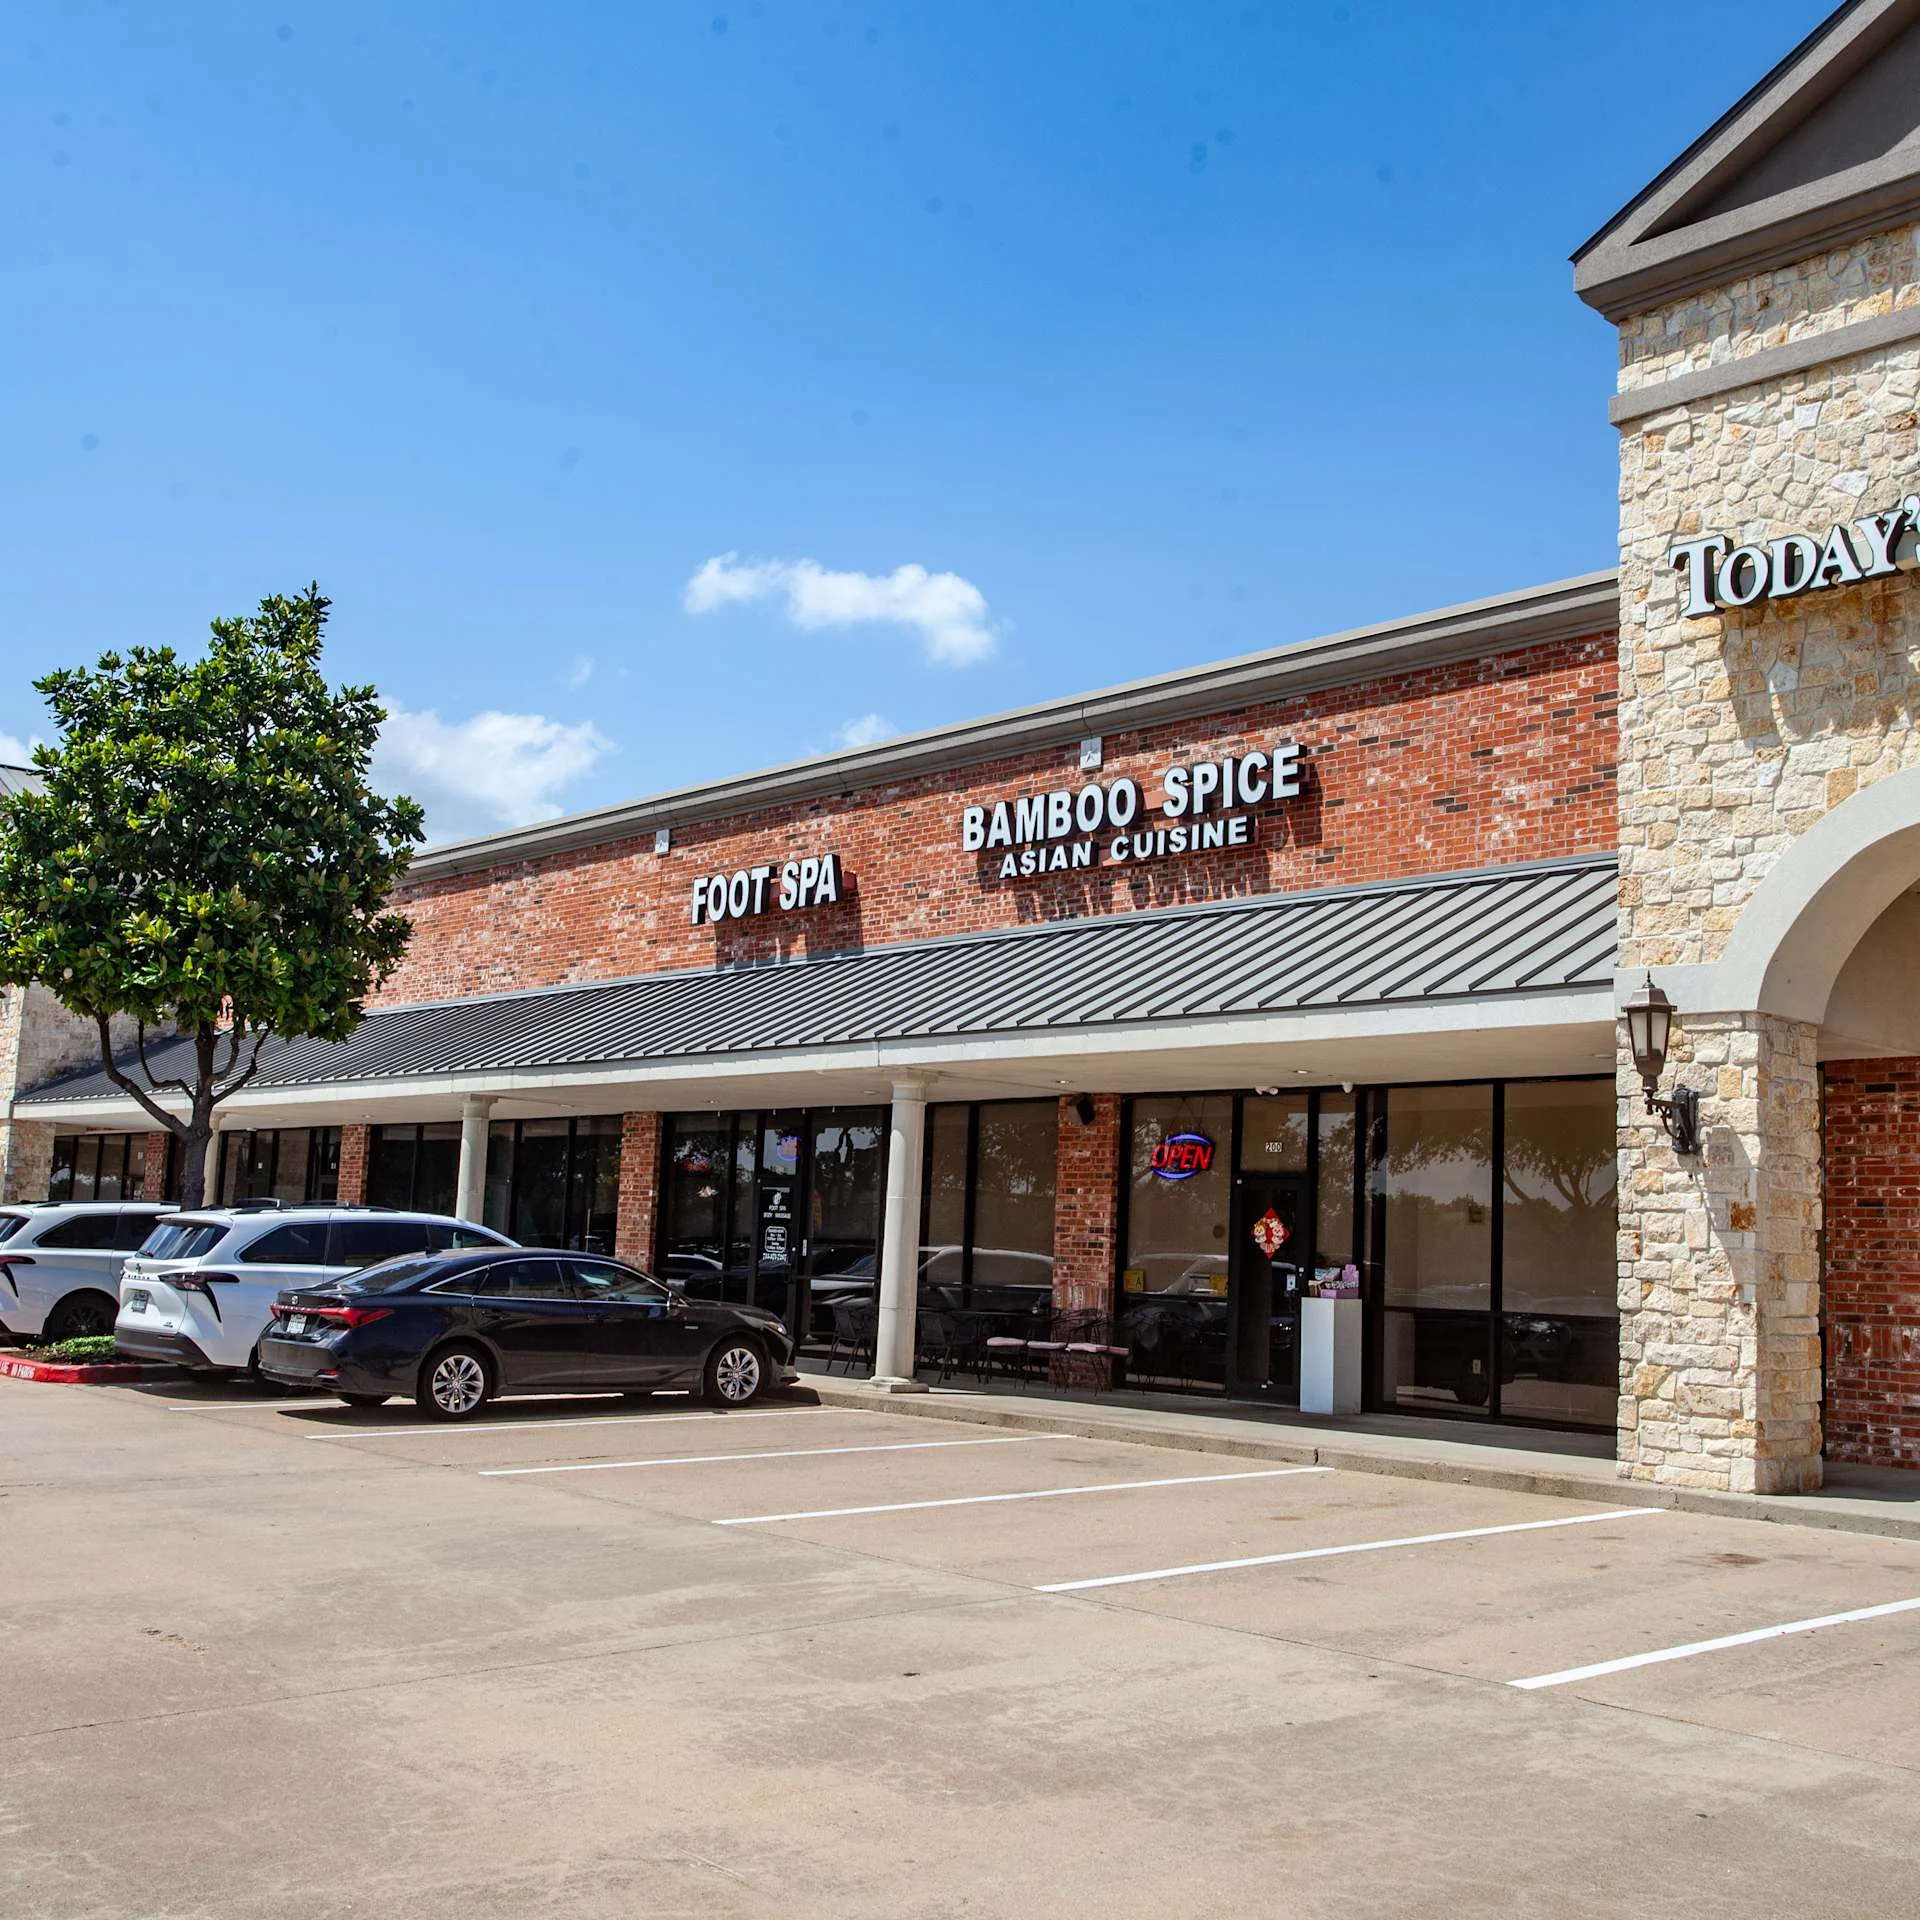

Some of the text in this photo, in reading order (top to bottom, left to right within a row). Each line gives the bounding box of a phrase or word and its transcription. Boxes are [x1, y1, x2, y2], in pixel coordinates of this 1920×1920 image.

[1669, 494, 1920, 617] TODAY'
[962, 743, 1302, 852] BAMBOO SPICE
[999, 815, 1249, 879] ASIAN CUISINE
[691, 853, 839, 924] FOOT SPA
[1151, 1144, 1213, 1169] OPEN
[1265, 1142, 1282, 1152] 200
